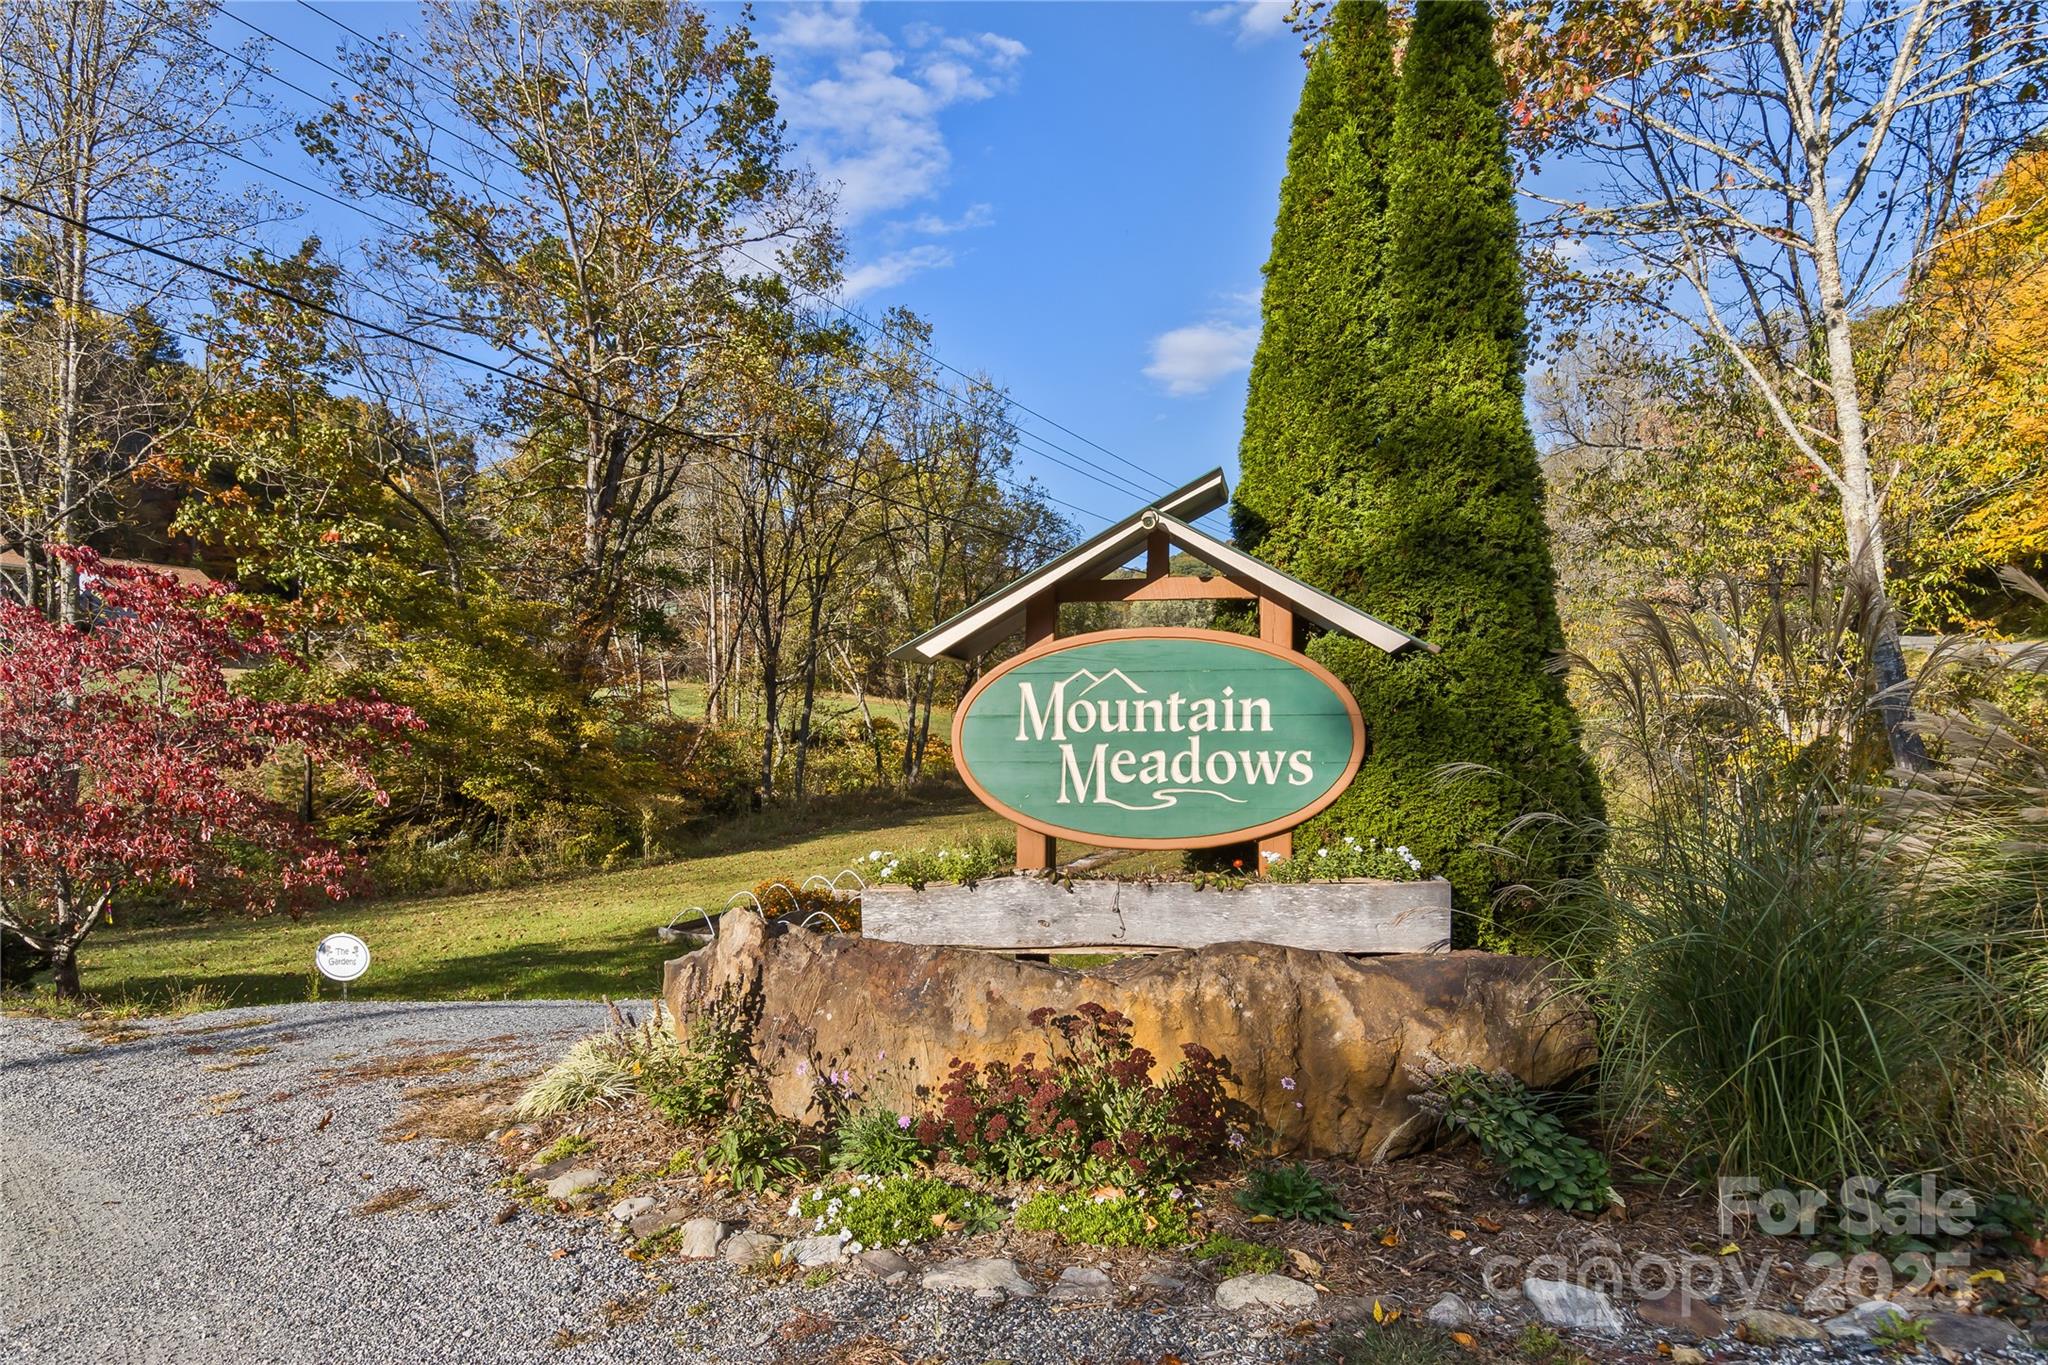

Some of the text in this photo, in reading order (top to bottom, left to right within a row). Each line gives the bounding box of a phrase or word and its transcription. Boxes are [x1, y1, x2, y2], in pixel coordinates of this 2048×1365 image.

[1015, 681, 1273, 742] Mountain
[1057, 736, 1314, 804] Meadows
[328, 957, 357, 966] Gardens
[335, 948, 349, 956] The
